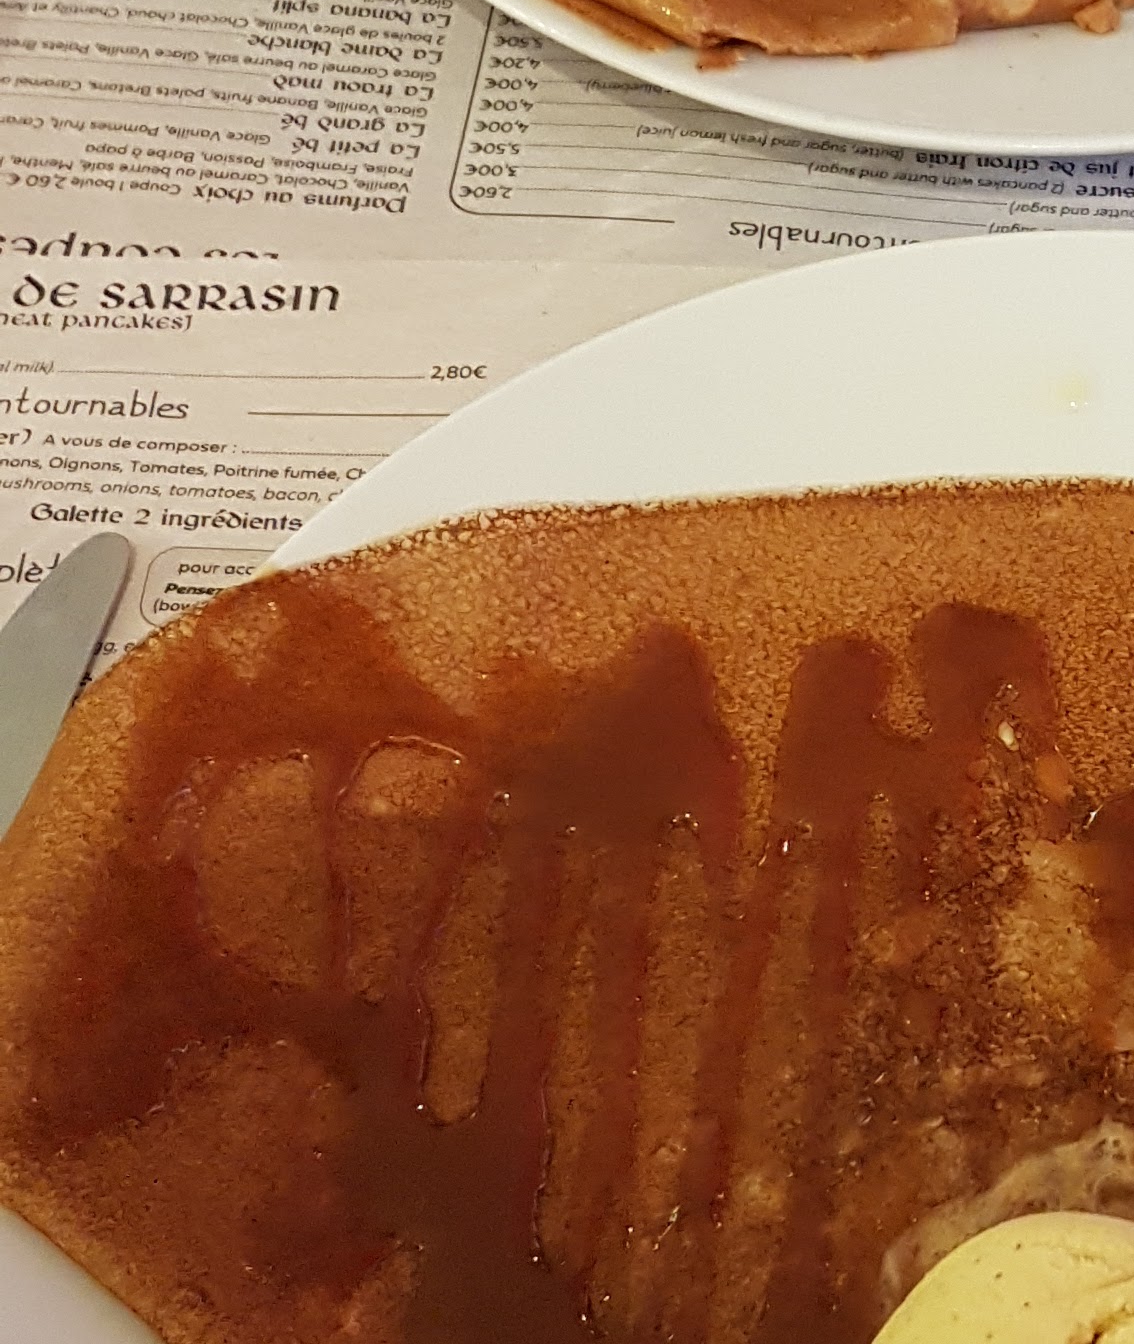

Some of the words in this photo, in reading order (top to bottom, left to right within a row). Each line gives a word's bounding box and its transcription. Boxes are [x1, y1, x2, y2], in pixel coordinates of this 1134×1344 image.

[246, 33, 332, 57] blanche
[340, 42, 404, 63] dame
[412, 48, 444, 66] La
[280, 112, 309, 131] bé
[317, 116, 386, 133] grand
[395, 121, 426, 139] La
[192, 183, 254, 205] choix
[264, 190, 294, 204] au
[303, 193, 407, 214] Parfums
[430, 364, 488, 382] 2,80€
[42, 433, 56, 446] A
[61, 436, 104, 448] vous
[108, 436, 132, 450] de
[136, 440, 228, 455] composer
[48, 456, 123, 474] Oignons,
[130, 459, 209, 478] Tomates,
[213, 463, 280, 479] Poitrine
[283, 465, 341, 482] fumée,
[30, 502, 124, 524] Galette
[133, 508, 151, 526] 2
[161, 508, 304, 532] ingrédients
